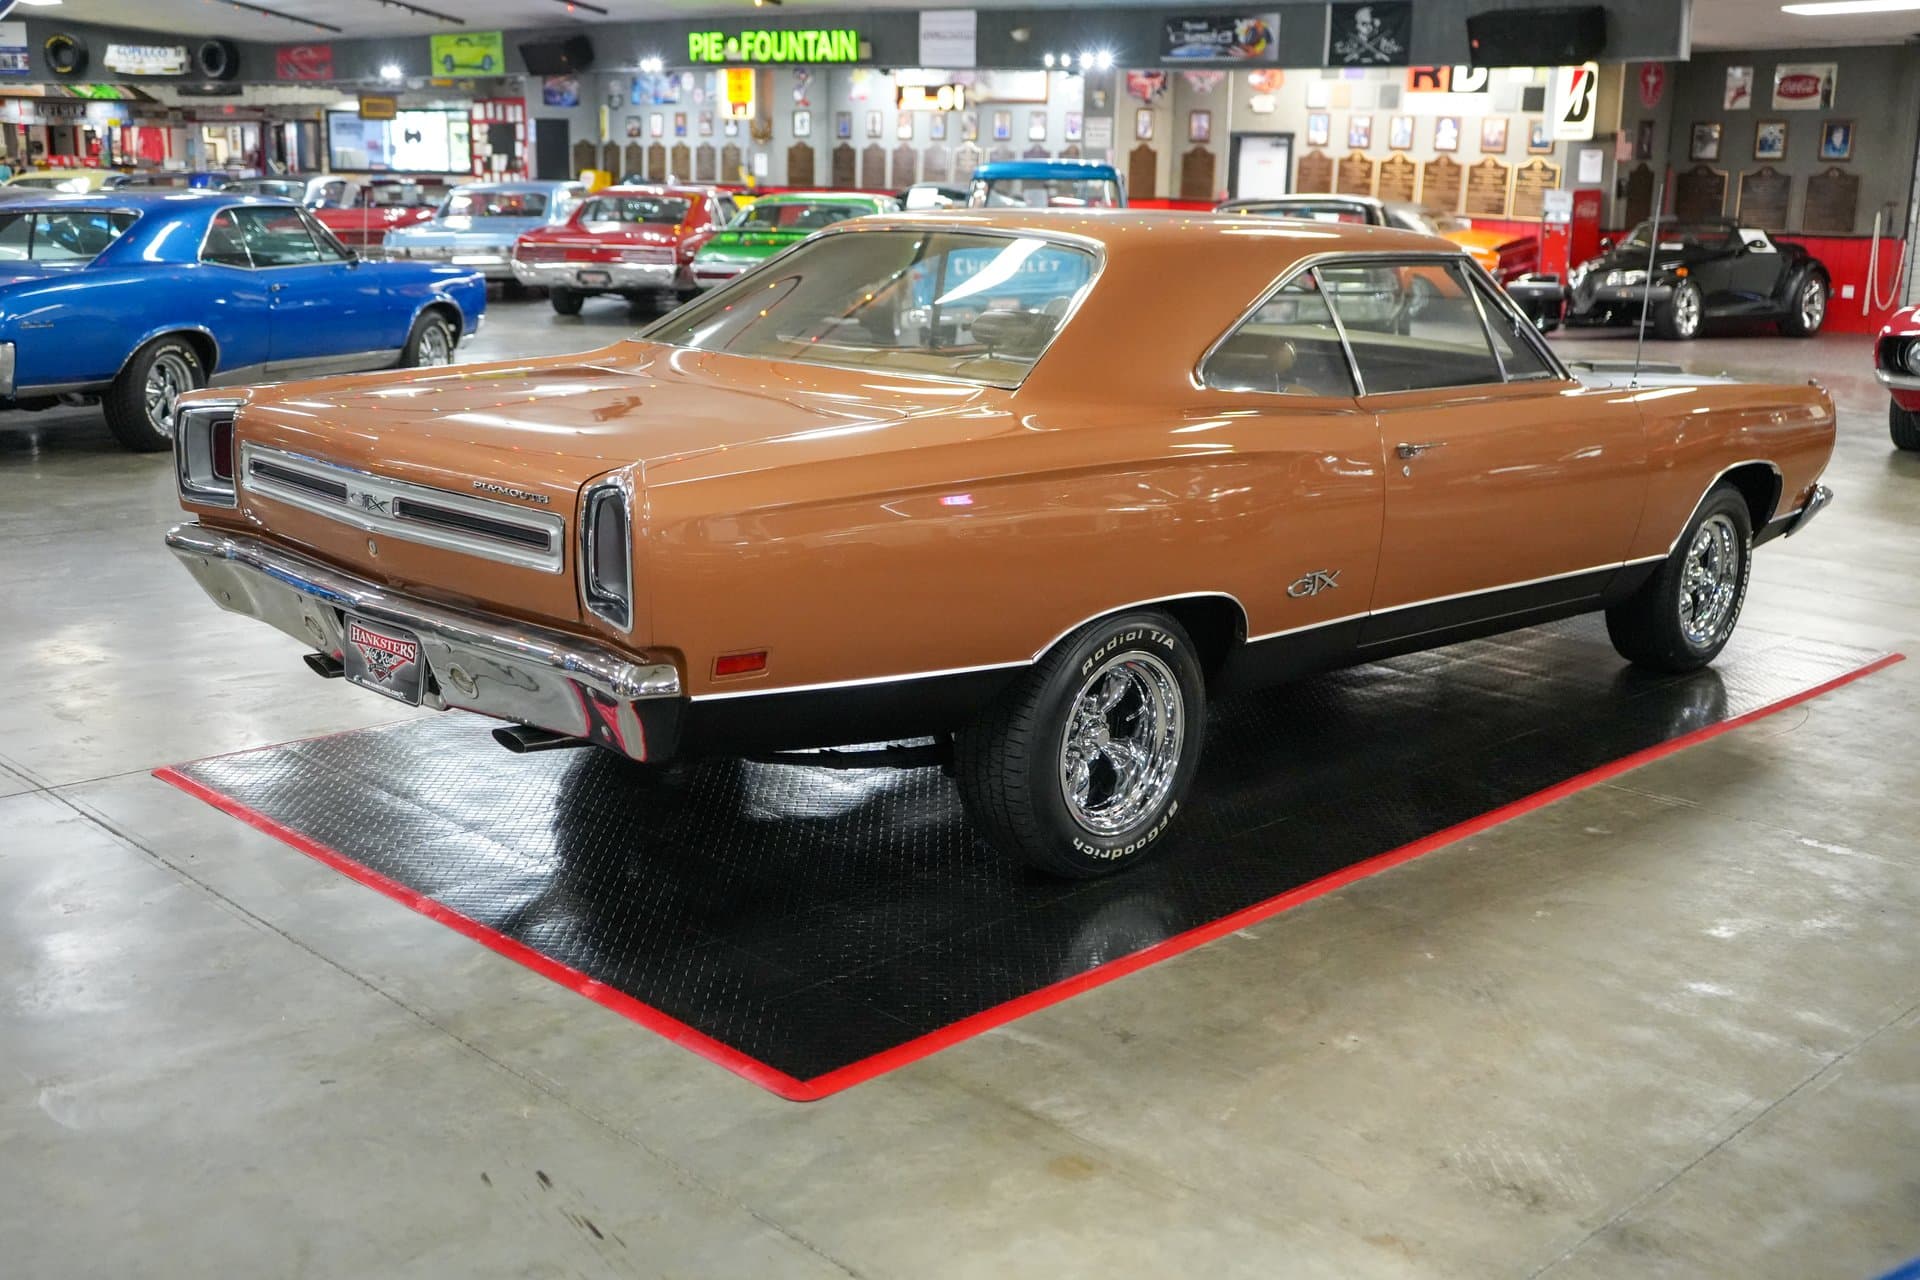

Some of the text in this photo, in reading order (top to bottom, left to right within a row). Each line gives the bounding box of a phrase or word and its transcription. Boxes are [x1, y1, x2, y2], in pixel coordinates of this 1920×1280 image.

[688, 30, 858, 62] PIE FOUNTAIN
[472, 480, 549, 504] PLYMOUTH
[1287, 568, 1343, 597] GTX
[351, 626, 414, 659] HANKSTERS
[1082, 629, 1175, 676] Radial T/A
